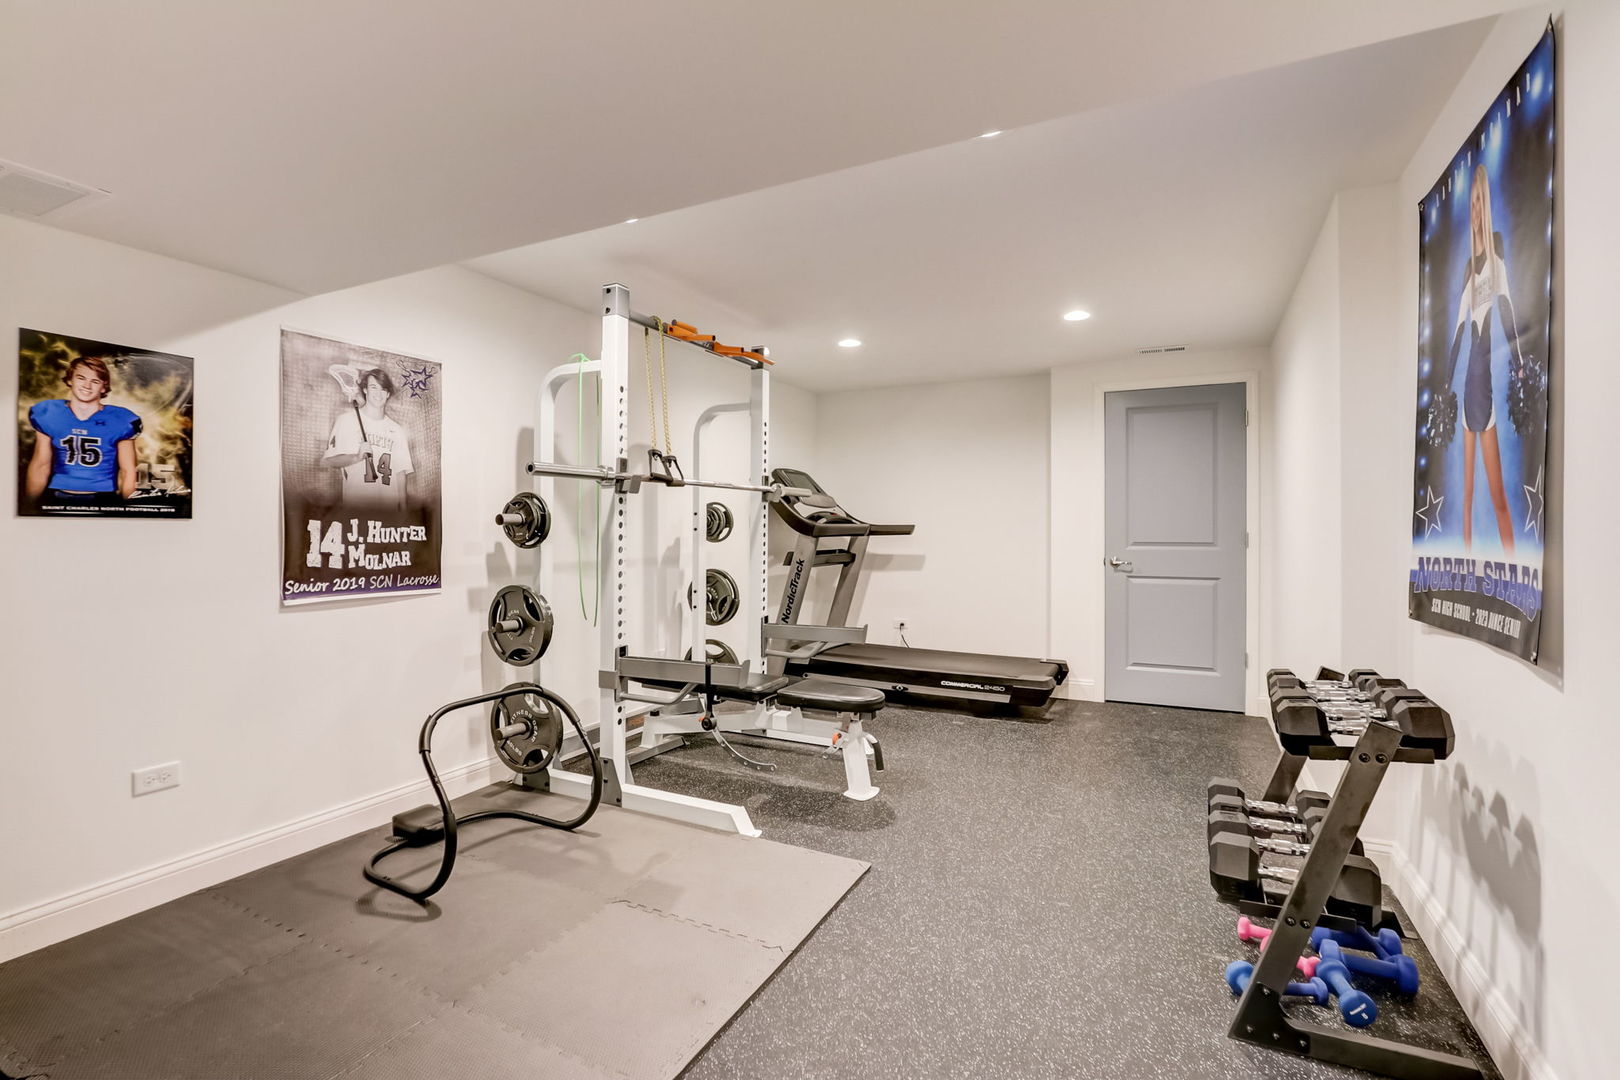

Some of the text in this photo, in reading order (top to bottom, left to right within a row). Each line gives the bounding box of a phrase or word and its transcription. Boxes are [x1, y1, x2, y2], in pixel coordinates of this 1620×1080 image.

[60, 435, 103, 467] 15
[135, 463, 176, 489] 15
[364, 452, 392, 486] 14
[306, 519, 345, 569] 14
[347, 519, 427, 544] J. HUNTER
[348, 543, 411, 570] MOLNAR
[285, 574, 439, 595] Senior 2019 SCN Lacrosse
[781, 558, 805, 624] NordicTrack
[1414, 556, 1539, 622] NORTH STARS
[941, 680, 984, 690] COMMERCIAL
[510, 709, 533, 724] FITNESS
